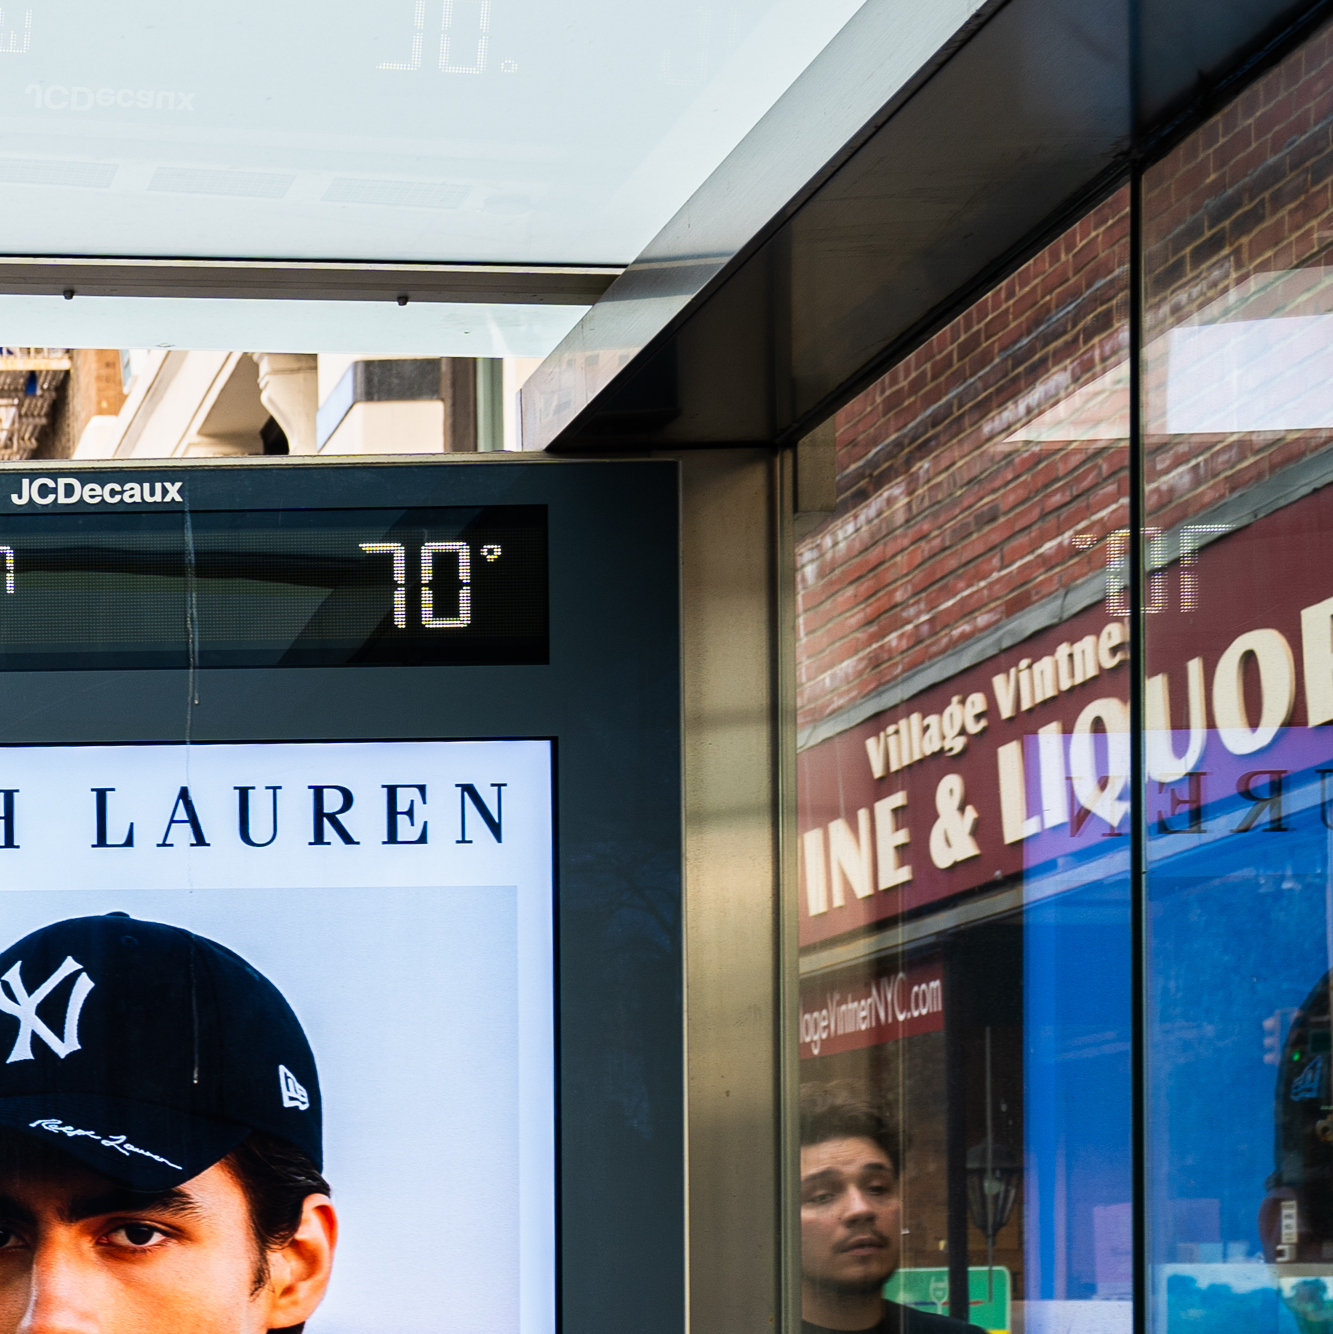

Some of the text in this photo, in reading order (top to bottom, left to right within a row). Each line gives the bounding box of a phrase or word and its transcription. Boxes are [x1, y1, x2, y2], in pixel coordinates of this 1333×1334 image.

[11, 477, 184, 506] JCDecaux
[358, 541, 502, 629] 70°
[865, 618, 1131, 779] Village Vintne
[90, 782, 508, 848] LAUREN
[797, 790, 912, 917] INE
[929, 773, 981, 869] &
